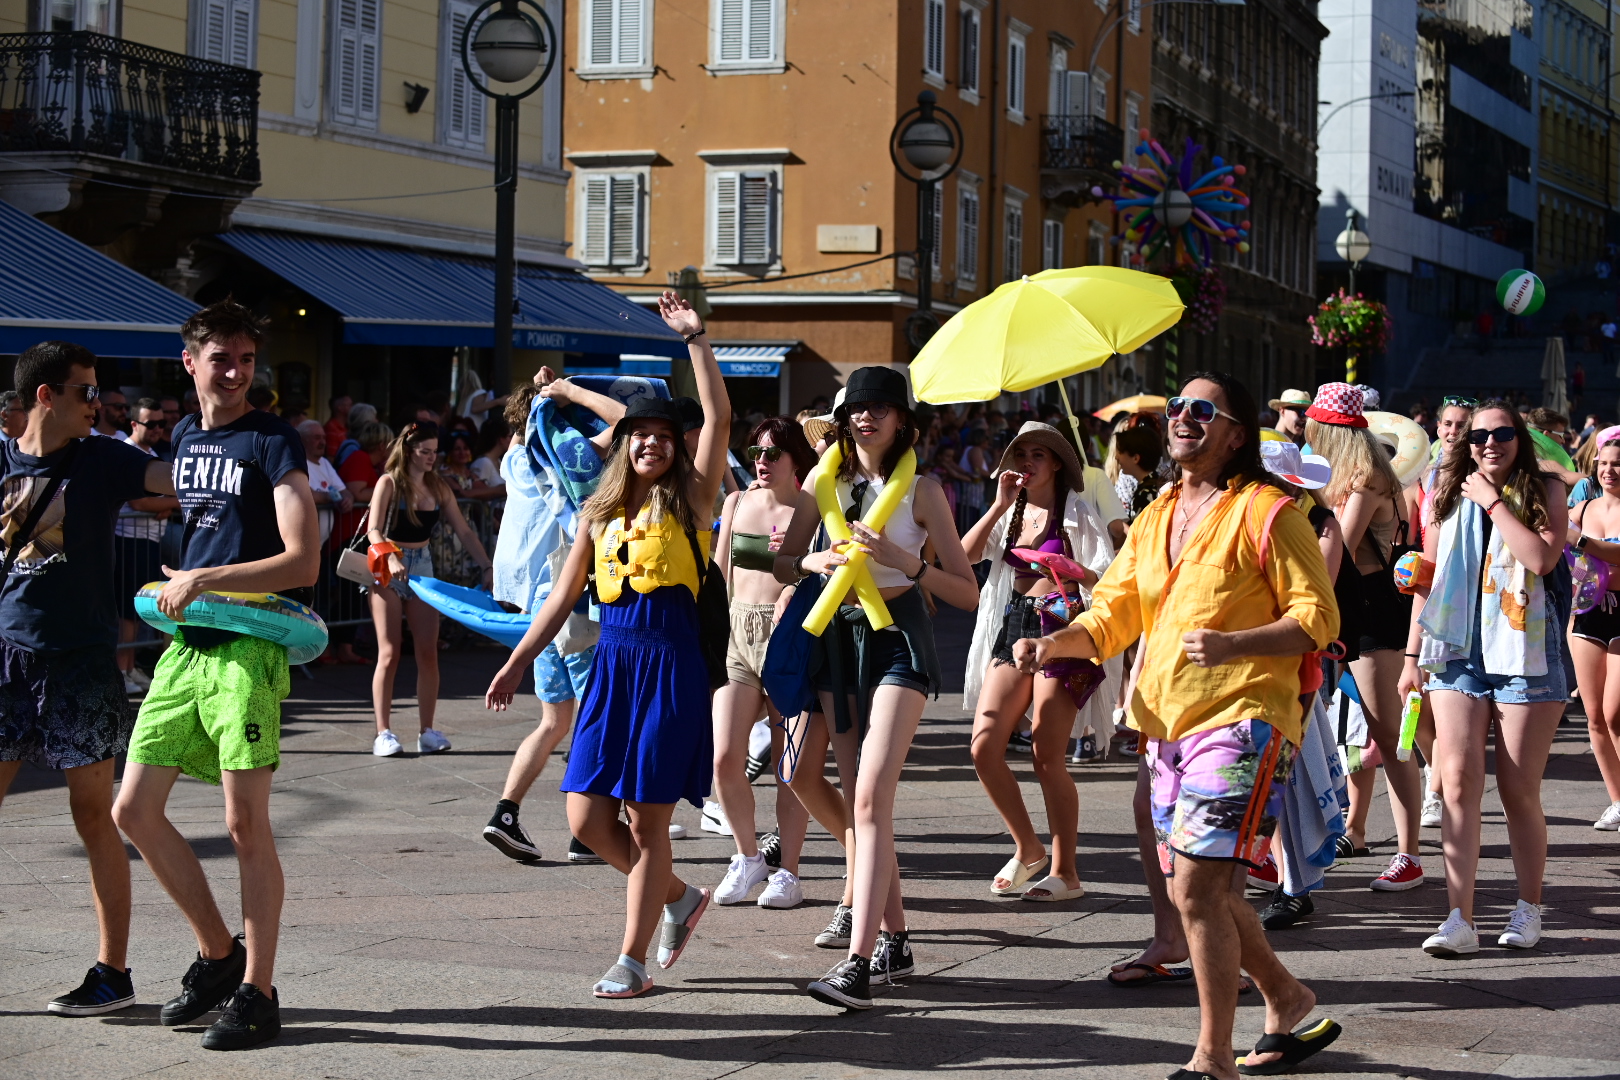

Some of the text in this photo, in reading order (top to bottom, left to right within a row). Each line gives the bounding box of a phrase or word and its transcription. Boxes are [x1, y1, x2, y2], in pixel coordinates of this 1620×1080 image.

[1511, 278, 1531, 309] FUJIFILM
[730, 363, 771, 373] TOBACCO
[245, 723, 261, 743] B
